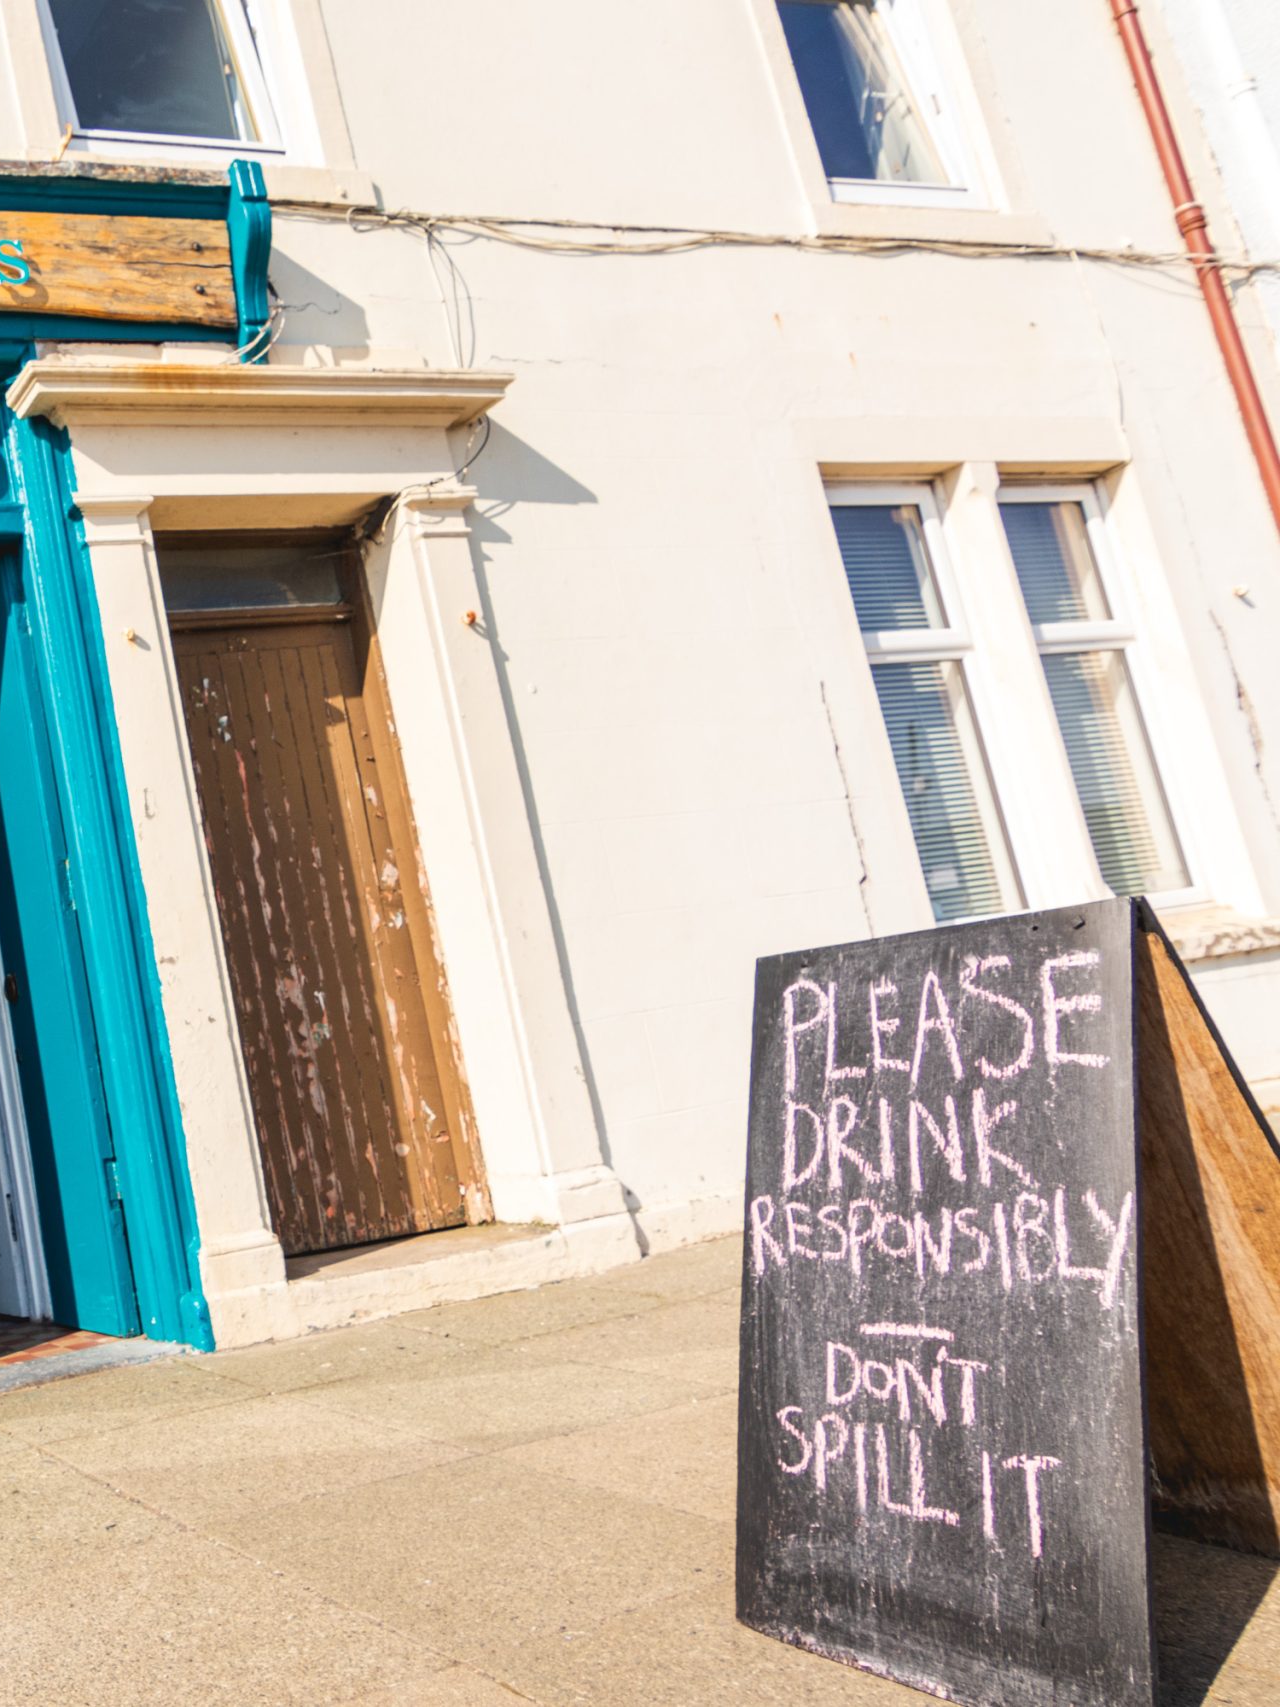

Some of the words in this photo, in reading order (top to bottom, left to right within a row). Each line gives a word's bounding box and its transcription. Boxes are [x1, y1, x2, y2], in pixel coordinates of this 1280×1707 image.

[782, 949, 1112, 1092] PLEASE
[781, 1087, 1040, 1197] DRINK
[750, 1187, 1135, 1310] RESPONSIBLY
[824, 1340, 989, 1427] DON'T
[775, 1403, 960, 1527] SPILL
[981, 1451, 1065, 1560] IT
